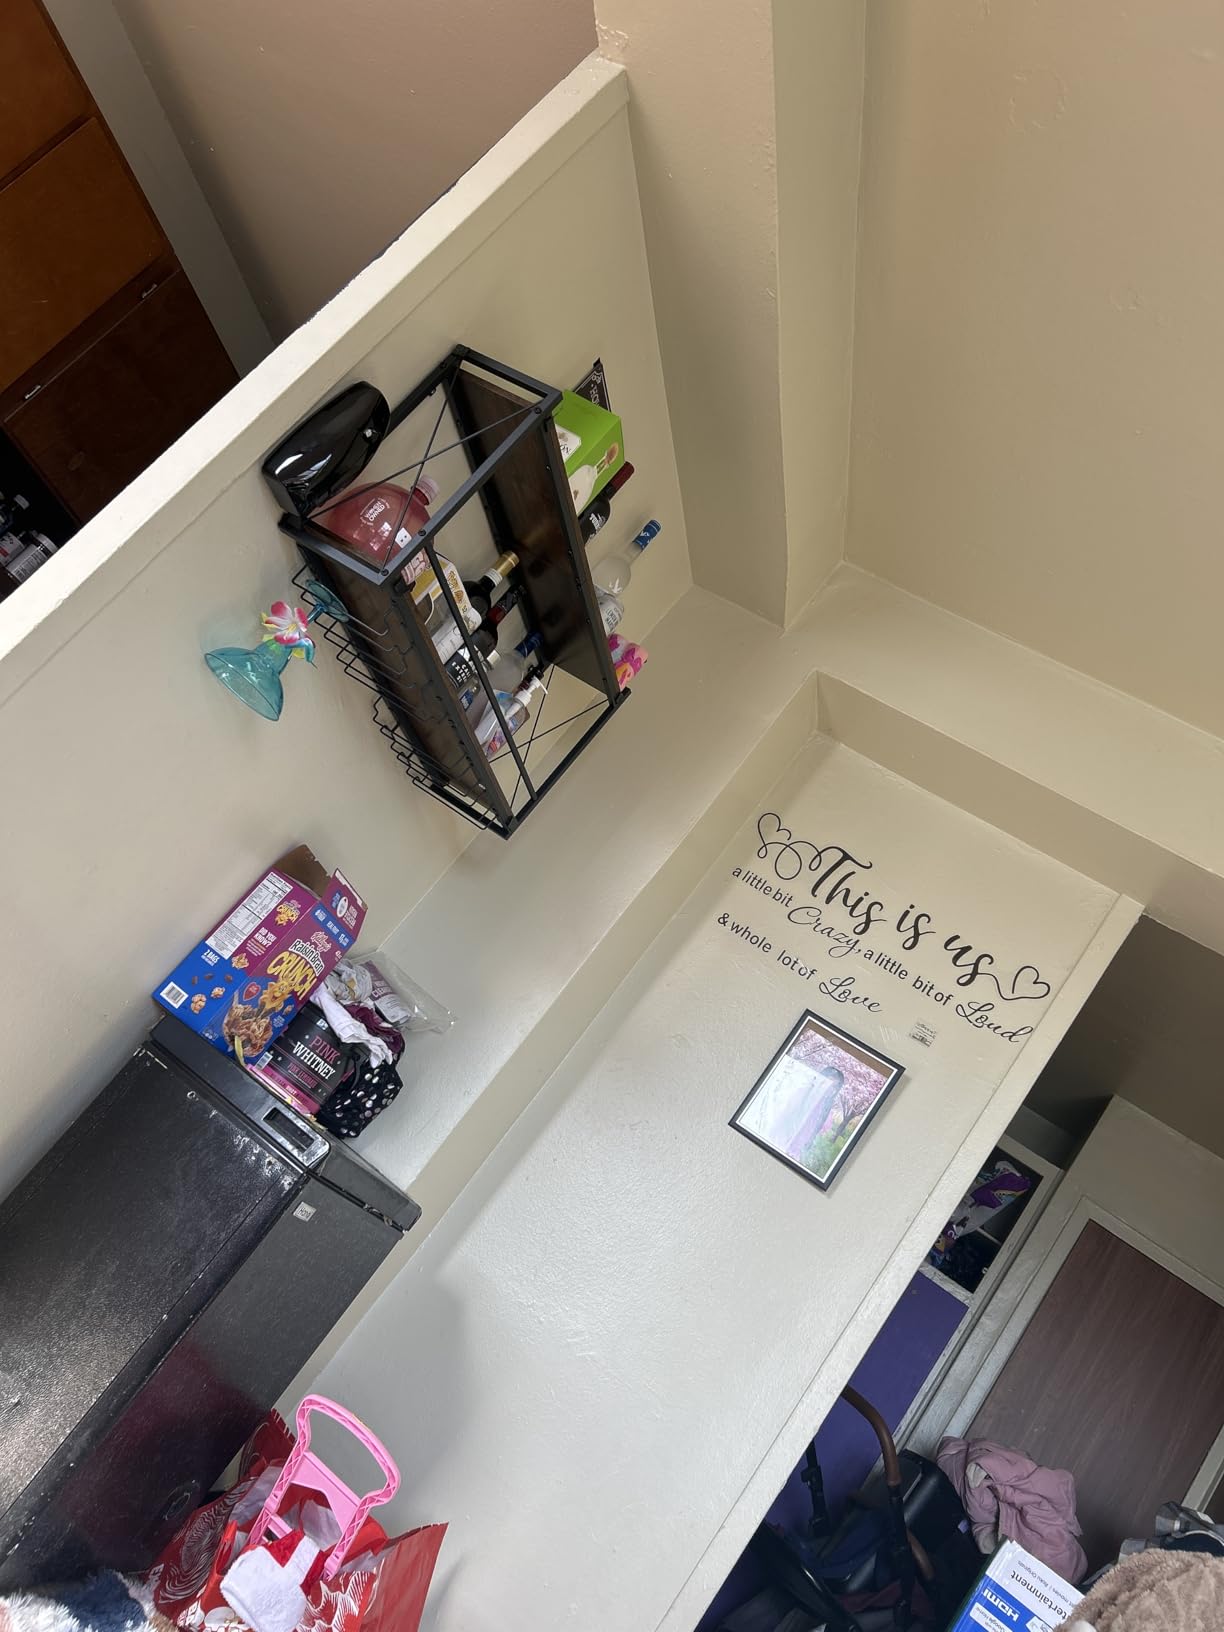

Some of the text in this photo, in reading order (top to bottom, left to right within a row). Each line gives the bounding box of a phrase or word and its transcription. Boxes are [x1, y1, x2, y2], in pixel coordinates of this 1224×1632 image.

[369, 504, 386, 521] OWNED
[809, 845, 995, 987] This is us
[265, 930, 277, 942] YOU
[732, 866, 743, 878] a
[741, 870, 773, 896] little
[772, 890, 796, 909] bit
[787, 906, 863, 959] Crazy,
[863, 948, 875, 960] a
[874, 952, 910, 980] little
[913, 976, 935, 998] bit
[933, 990, 954, 1007] of
[956, 1000, 1034, 1043] Loud
[207, 951, 220, 963] BAGS
[267, 951, 318, 999] CRUNCH
[289, 939, 314, 959] Raisin
[309, 953, 325, 976] Bran
[717, 912, 883, 1013] & whole lot of Love
[292, 1041, 336, 1080] WHITNEY
[309, 1035, 341, 1064] PINK
[982, 1588, 1020, 1622] HDMI
[1010, 1570, 1069, 1620] tertainment
